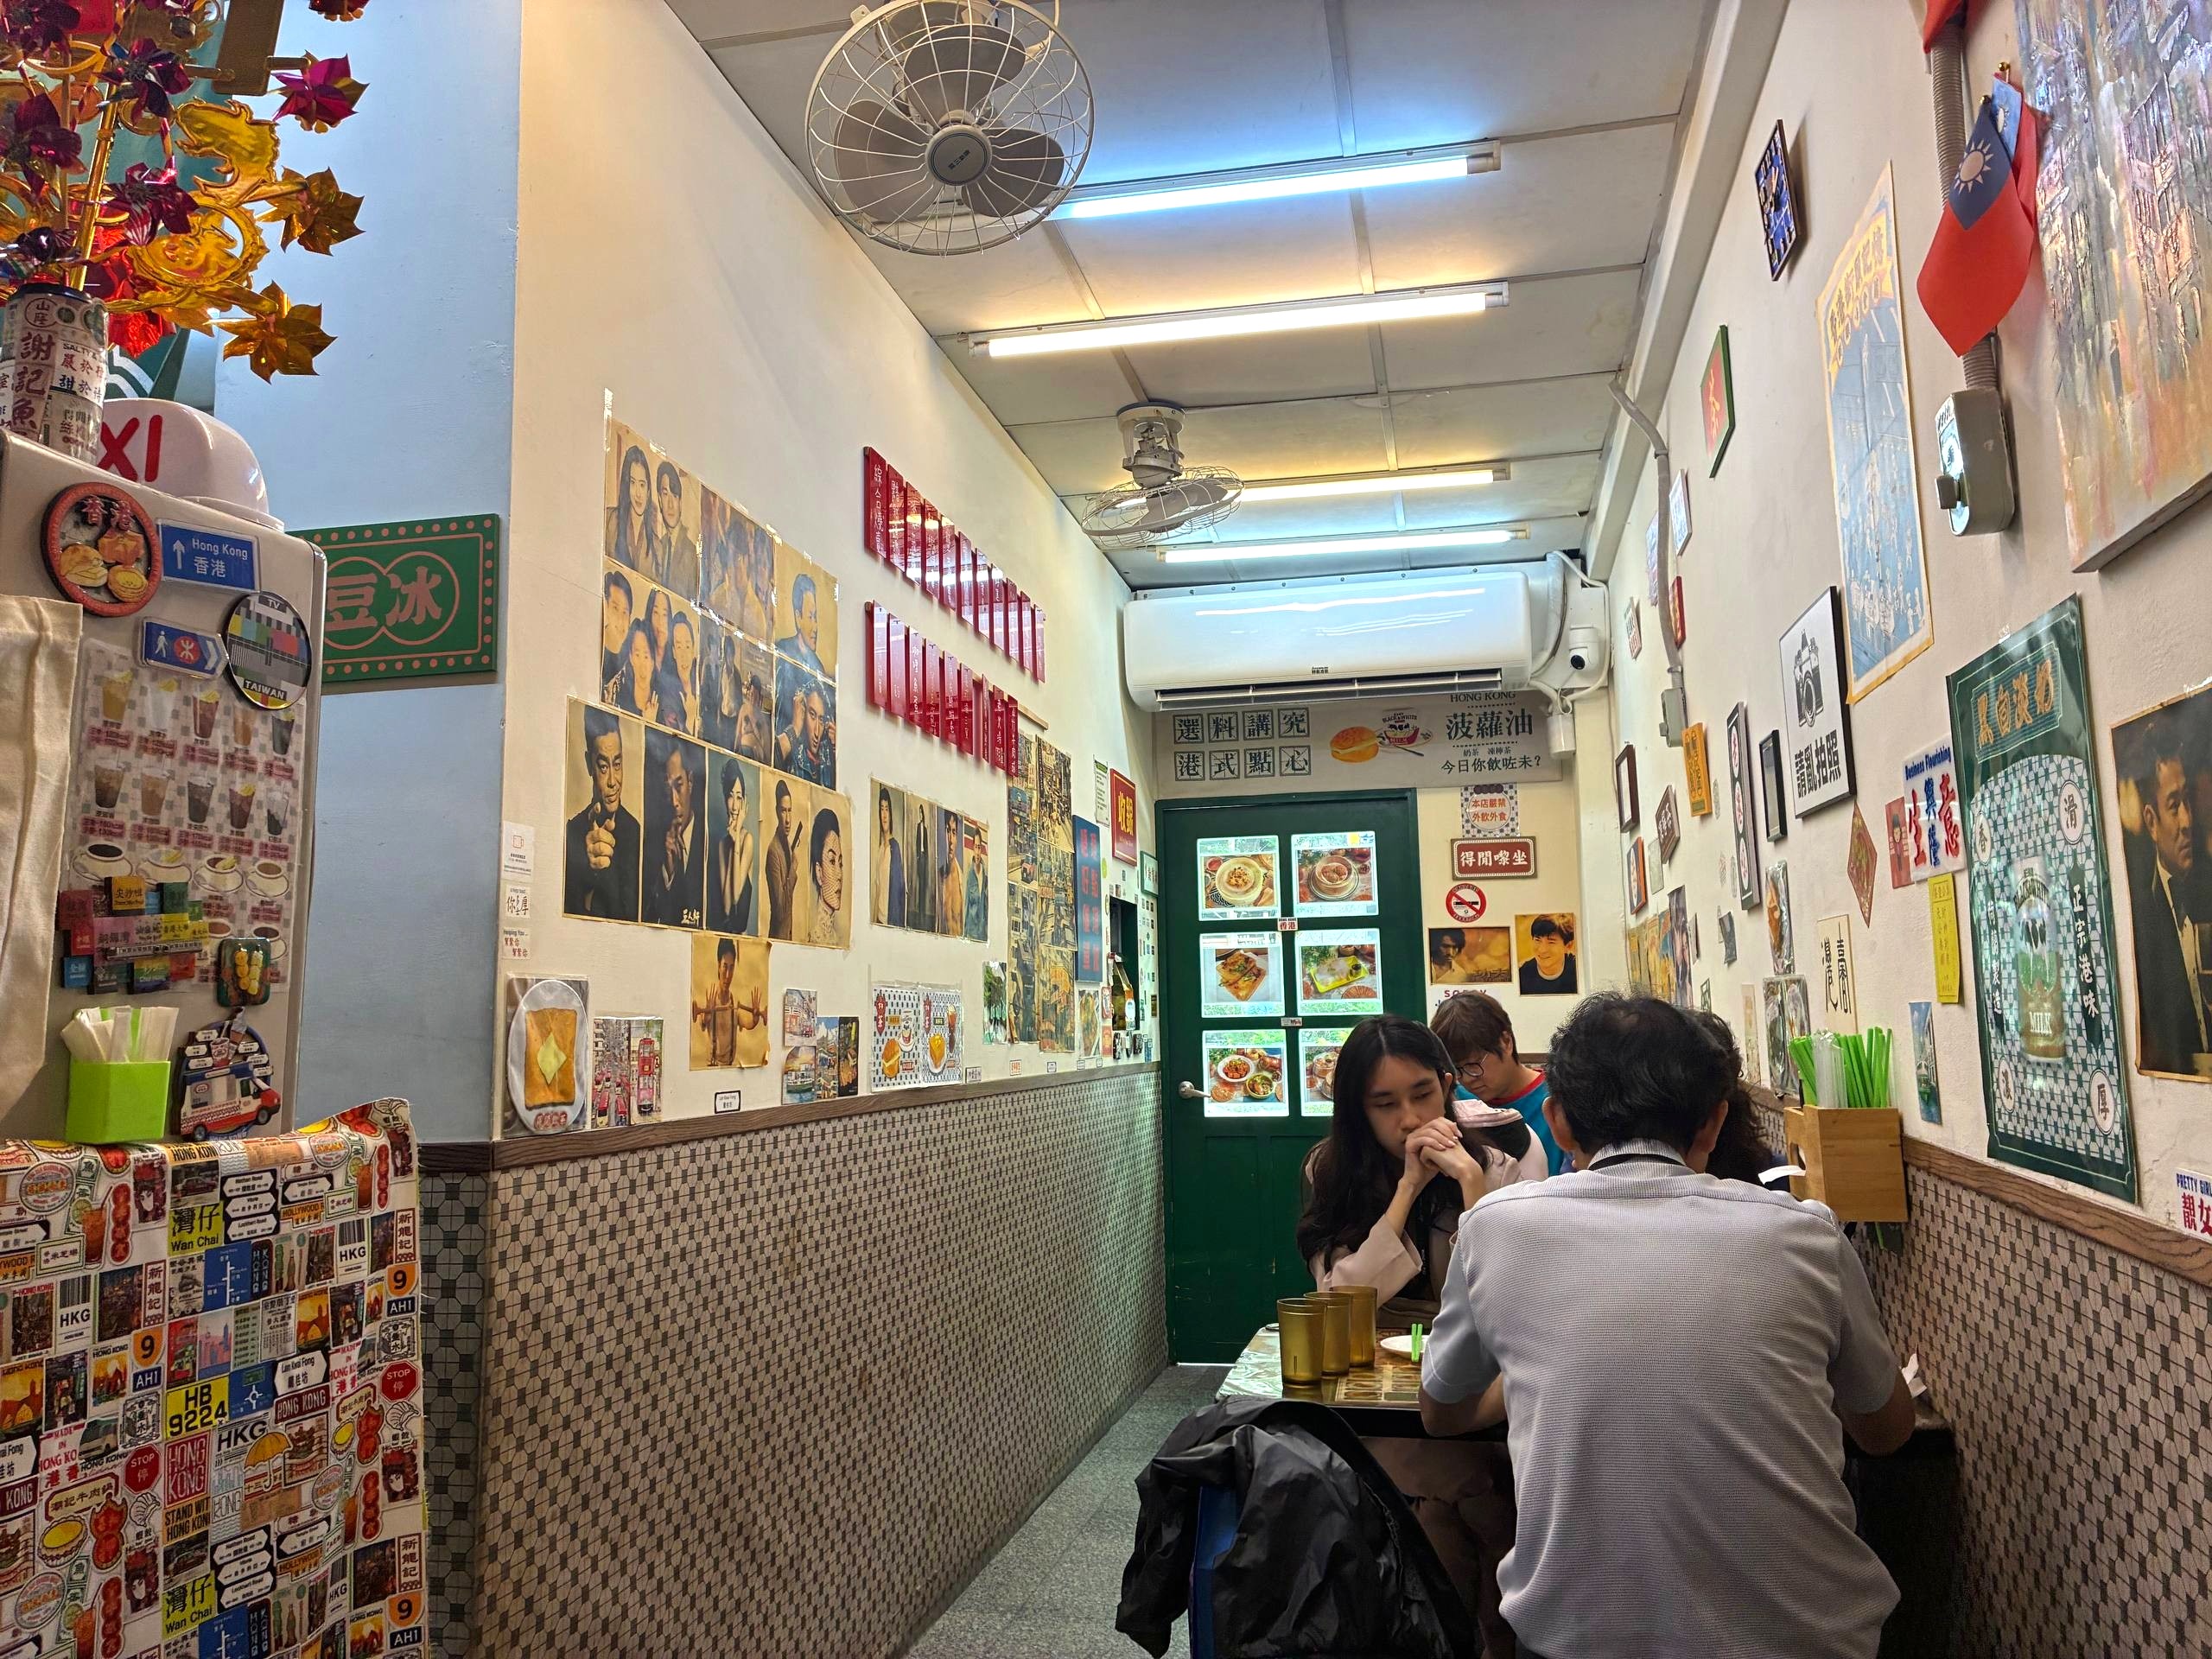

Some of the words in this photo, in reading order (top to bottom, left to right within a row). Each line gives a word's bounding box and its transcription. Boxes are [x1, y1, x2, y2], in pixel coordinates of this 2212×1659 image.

[12, 332, 54, 435] 謝記魚
[81, 496, 133, 531] 香港
[192, 538, 219, 555] Hong
[223, 544, 248, 561] Kong
[194, 556, 226, 578] 香港
[267, 599, 282, 609] TV
[245, 681, 285, 699] TAIWAN
[1451, 691, 1481, 703] HONG
[1484, 690, 1516, 701] KONG
[1177, 711, 1306, 741] 選料講究
[1446, 709, 1533, 741] 菠蘿油
[1178, 749, 1309, 777] 港式點心
[1926, 746, 1952, 770] Flourishing
[1472, 811, 1507, 823] 外飲外食
[2073, 883, 2100, 1019] 正宗港味
[1444, 989, 1487, 998] SOY
[2029, 1010, 2052, 1035] MILK
[174, 1146, 196, 1162] HONG
[2176, 1172, 2197, 1193] PRETTY
[172, 1204, 221, 1237] 灣仔
[171, 1237, 194, 1252] Wan
[196, 1233, 219, 1247] Chai
[340, 1246, 366, 1262] HKG
[393, 1269, 407, 1290] 9
[60, 1309, 90, 1328] HKG
[92, 1346, 112, 1358] HONG
[141, 1335, 156, 1359] 9
[386, 1369, 410, 1380] STOP
[185, 1382, 213, 1413] HB
[276, 1400, 299, 1417] HONG
[302, 1393, 326, 1409] KONG
[169, 1400, 227, 1438] 9224
[217, 1420, 268, 1452] HKG
[130, 1452, 155, 1468] STOP
[168, 1438, 206, 1466] HONG
[168, 1464, 207, 1500] KONG
[6, 1484, 34, 1510] KONG
[165, 1506, 191, 1526] STAND
[194, 1501, 210, 1515] WIT
[167, 1523, 189, 1541] HONG
[165, 1576, 212, 1618] 灣仔
[328, 1583, 347, 1603] HKG
[165, 1618, 187, 1635] Wan
[190, 1606, 213, 1622] Chai
[397, 1599, 413, 1620] 9
